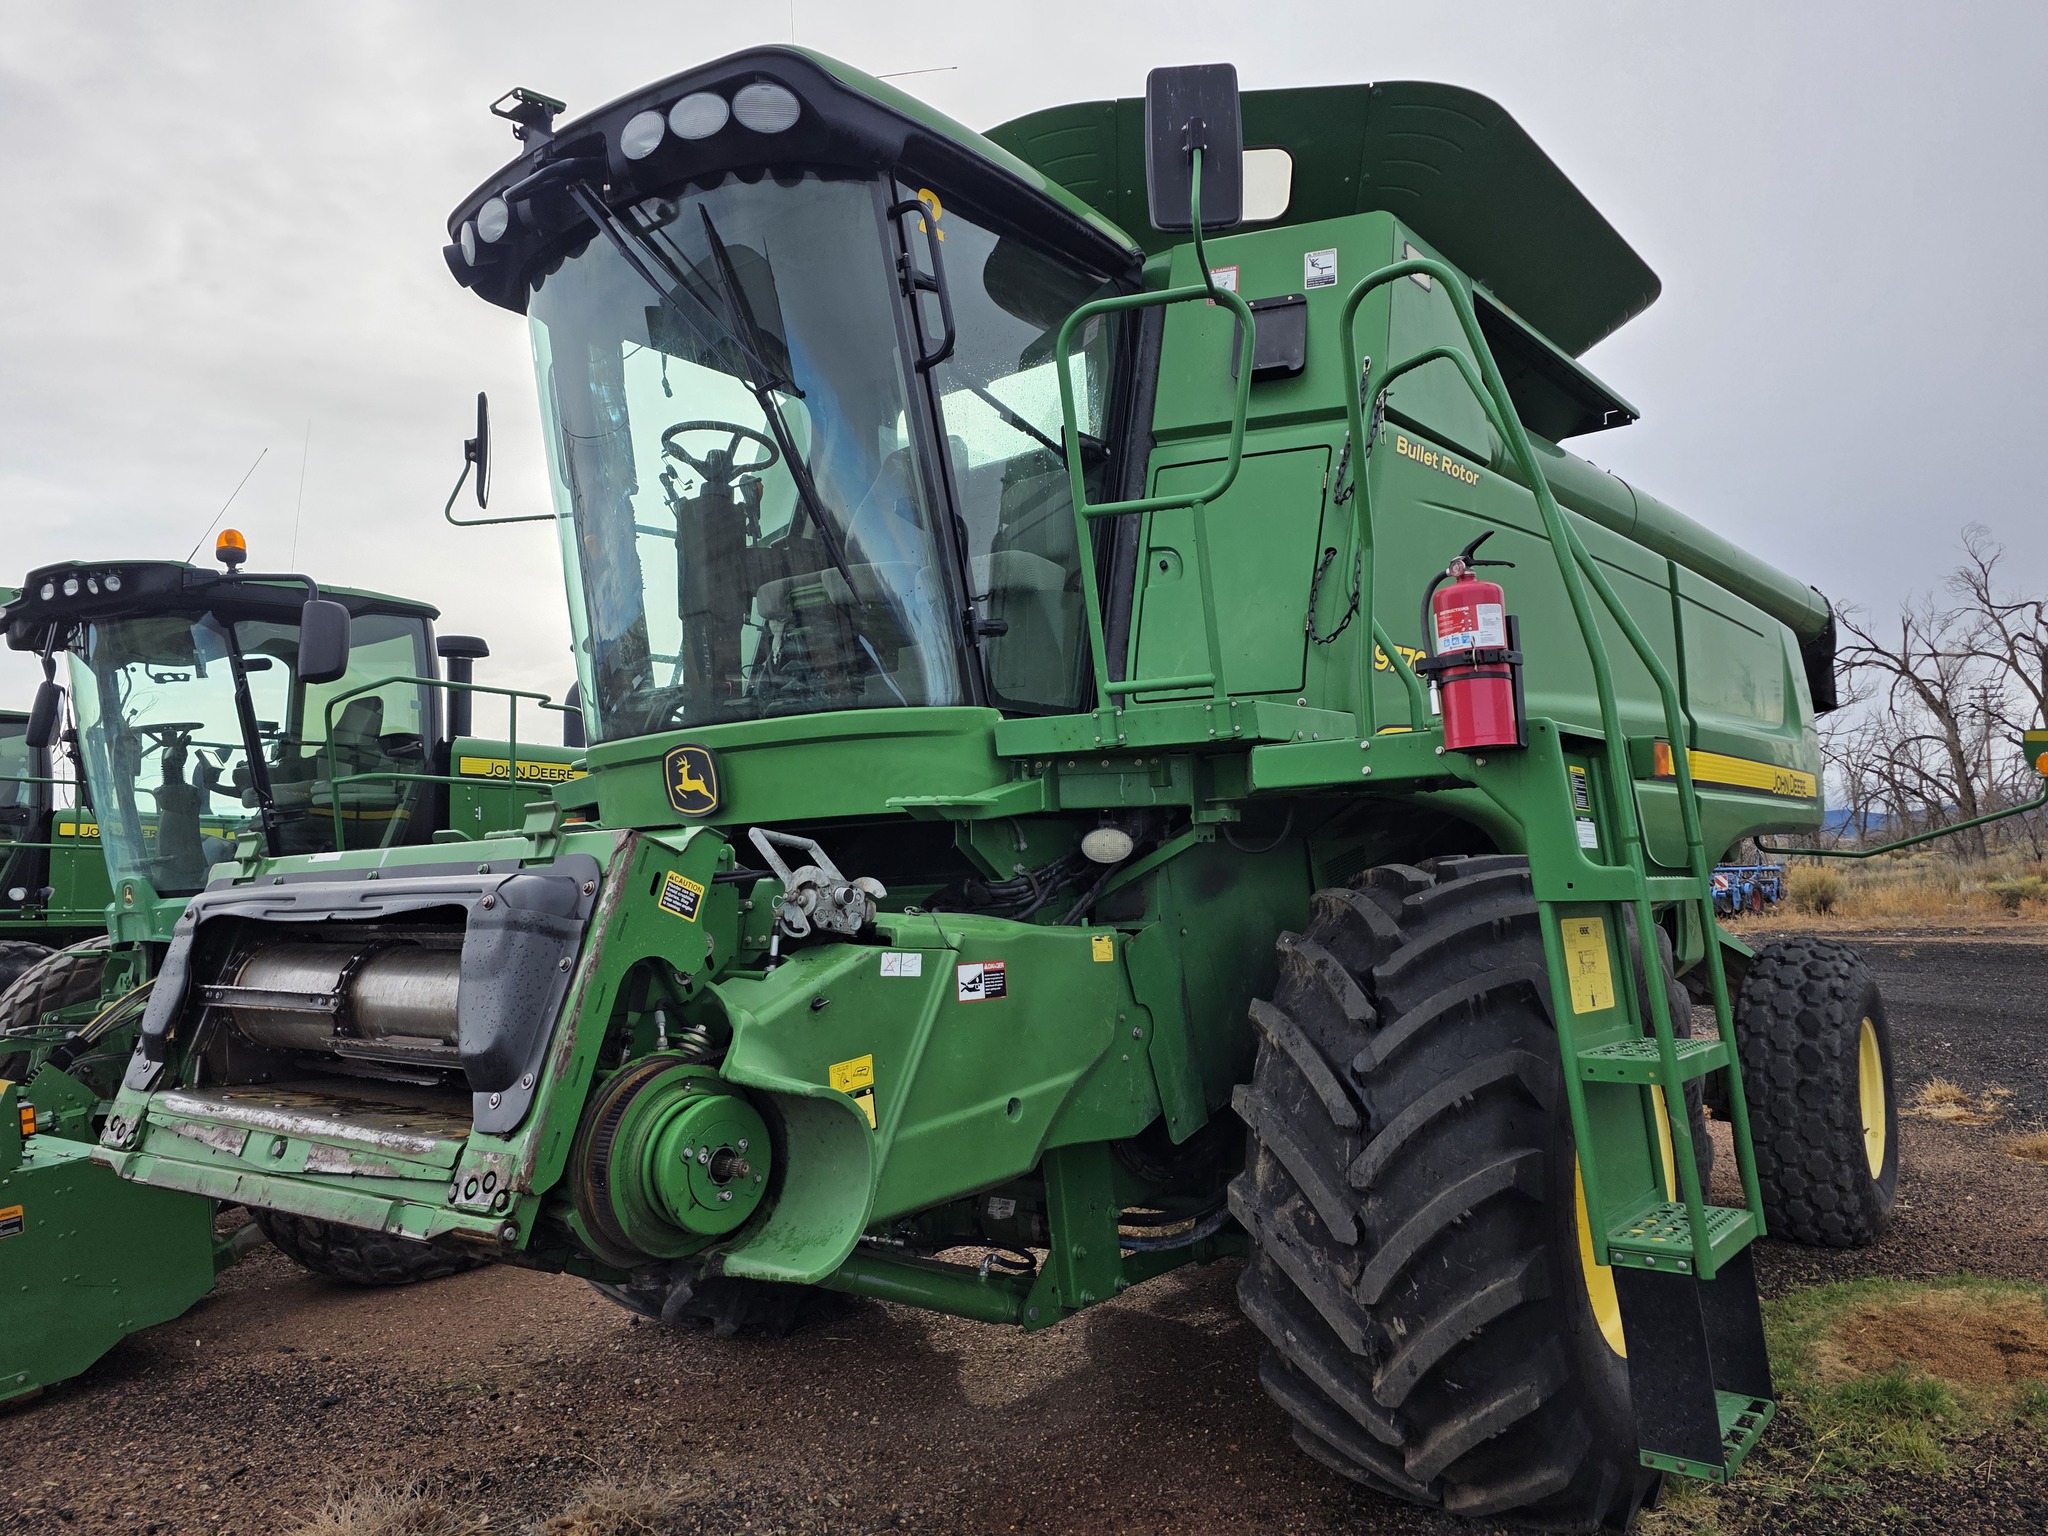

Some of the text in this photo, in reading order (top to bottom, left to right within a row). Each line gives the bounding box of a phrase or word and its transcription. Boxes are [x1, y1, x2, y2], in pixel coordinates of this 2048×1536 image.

[917, 188, 945, 242] 2
[1215, 266, 1237, 274] DANGER
[1396, 435, 1480, 486] Bullet Rotor
[1439, 606, 1470, 616] INSTRUCTIONS
[1374, 644, 1427, 678] 97
[486, 762, 574, 780] JOHN DEERE
[1772, 771, 1807, 796] JOHN DEERE
[674, 875, 703, 893] CAUTION
